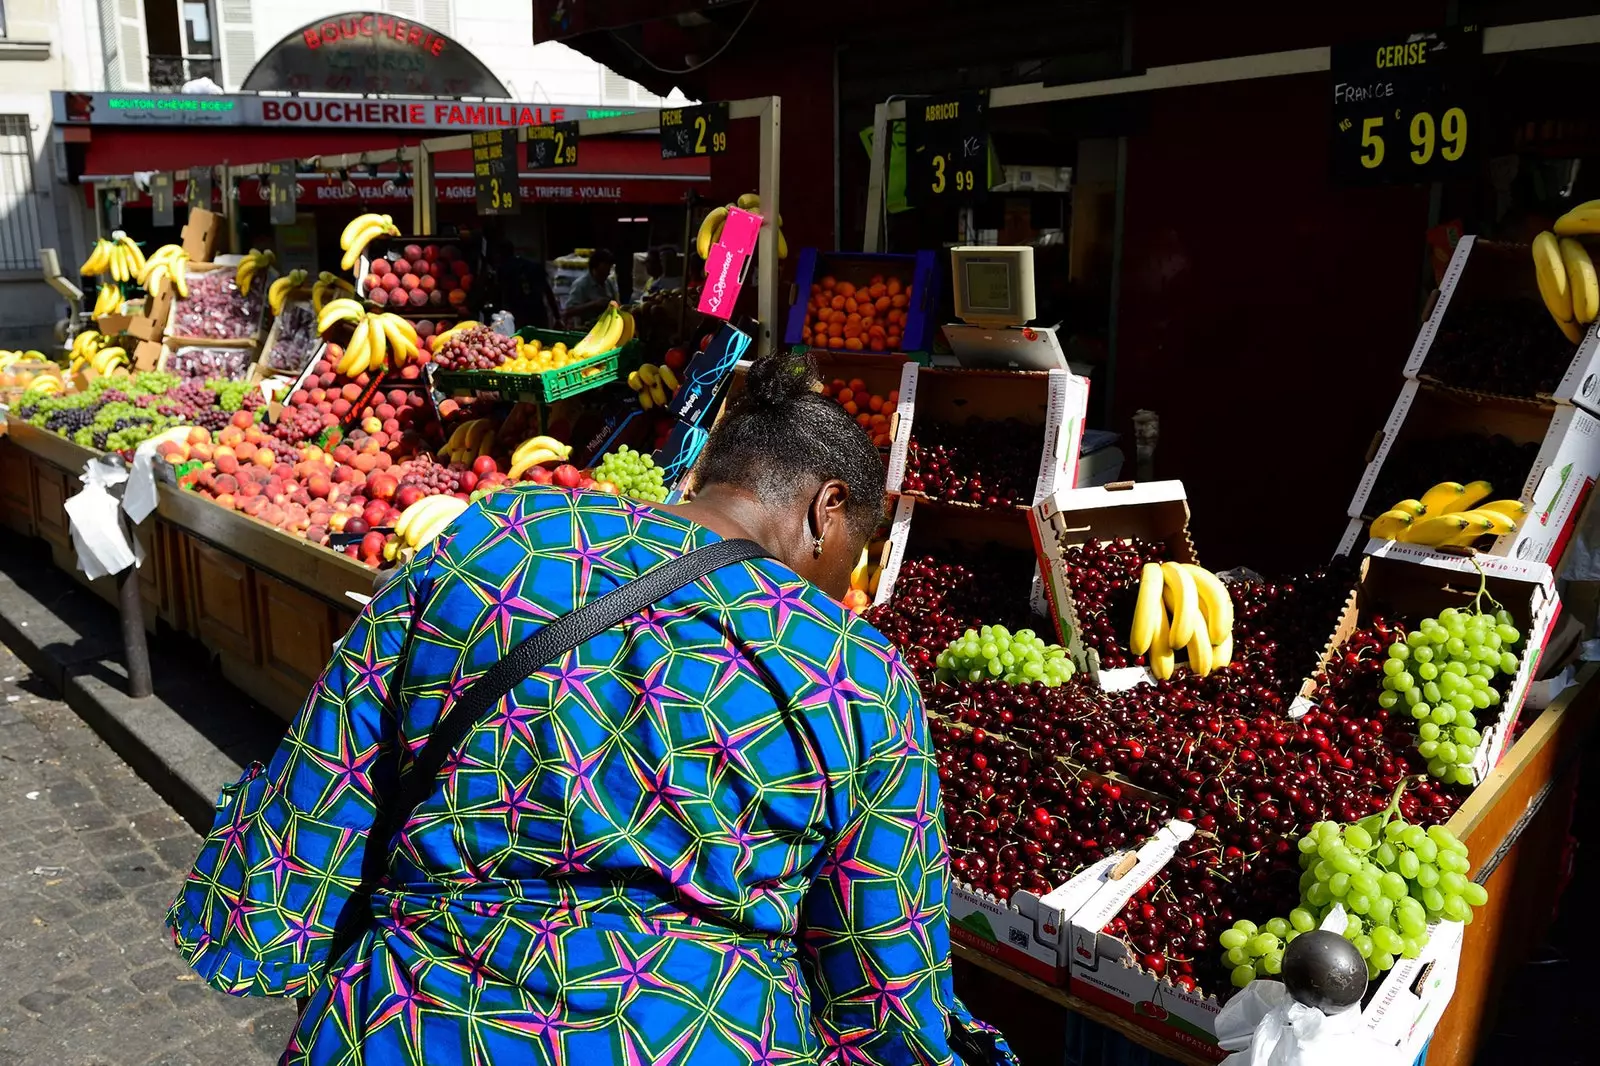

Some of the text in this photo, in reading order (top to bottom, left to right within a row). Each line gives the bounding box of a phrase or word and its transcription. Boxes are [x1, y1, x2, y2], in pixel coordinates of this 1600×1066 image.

[303, 15, 447, 57] BOUCHERIE
[1376, 41, 1428, 69] CERISE
[108, 98, 154, 109] MOUTON
[1334, 82, 1395, 104] FRANCE
[262, 100, 565, 126] BOUCHERIE FAMILIALE
[662, 109, 683, 126] PECHE
[925, 102, 960, 122] ABRICOT
[553, 131, 577, 165] 2 99
[695, 116, 707, 154] 2
[713, 132, 727, 152] 99
[1360, 116, 1385, 169] 5
[1409, 106, 1468, 165] 99
[932, 155, 946, 193] 3
[956, 170, 974, 191] 99
[316, 186, 345, 199] BOEU
[446, 186, 476, 199] AGNEA
[534, 186, 573, 199] TRIPERIE
[579, 186, 621, 200] VOLAILLE
[490, 178, 500, 208] 3
[502, 191, 513, 209] 99
